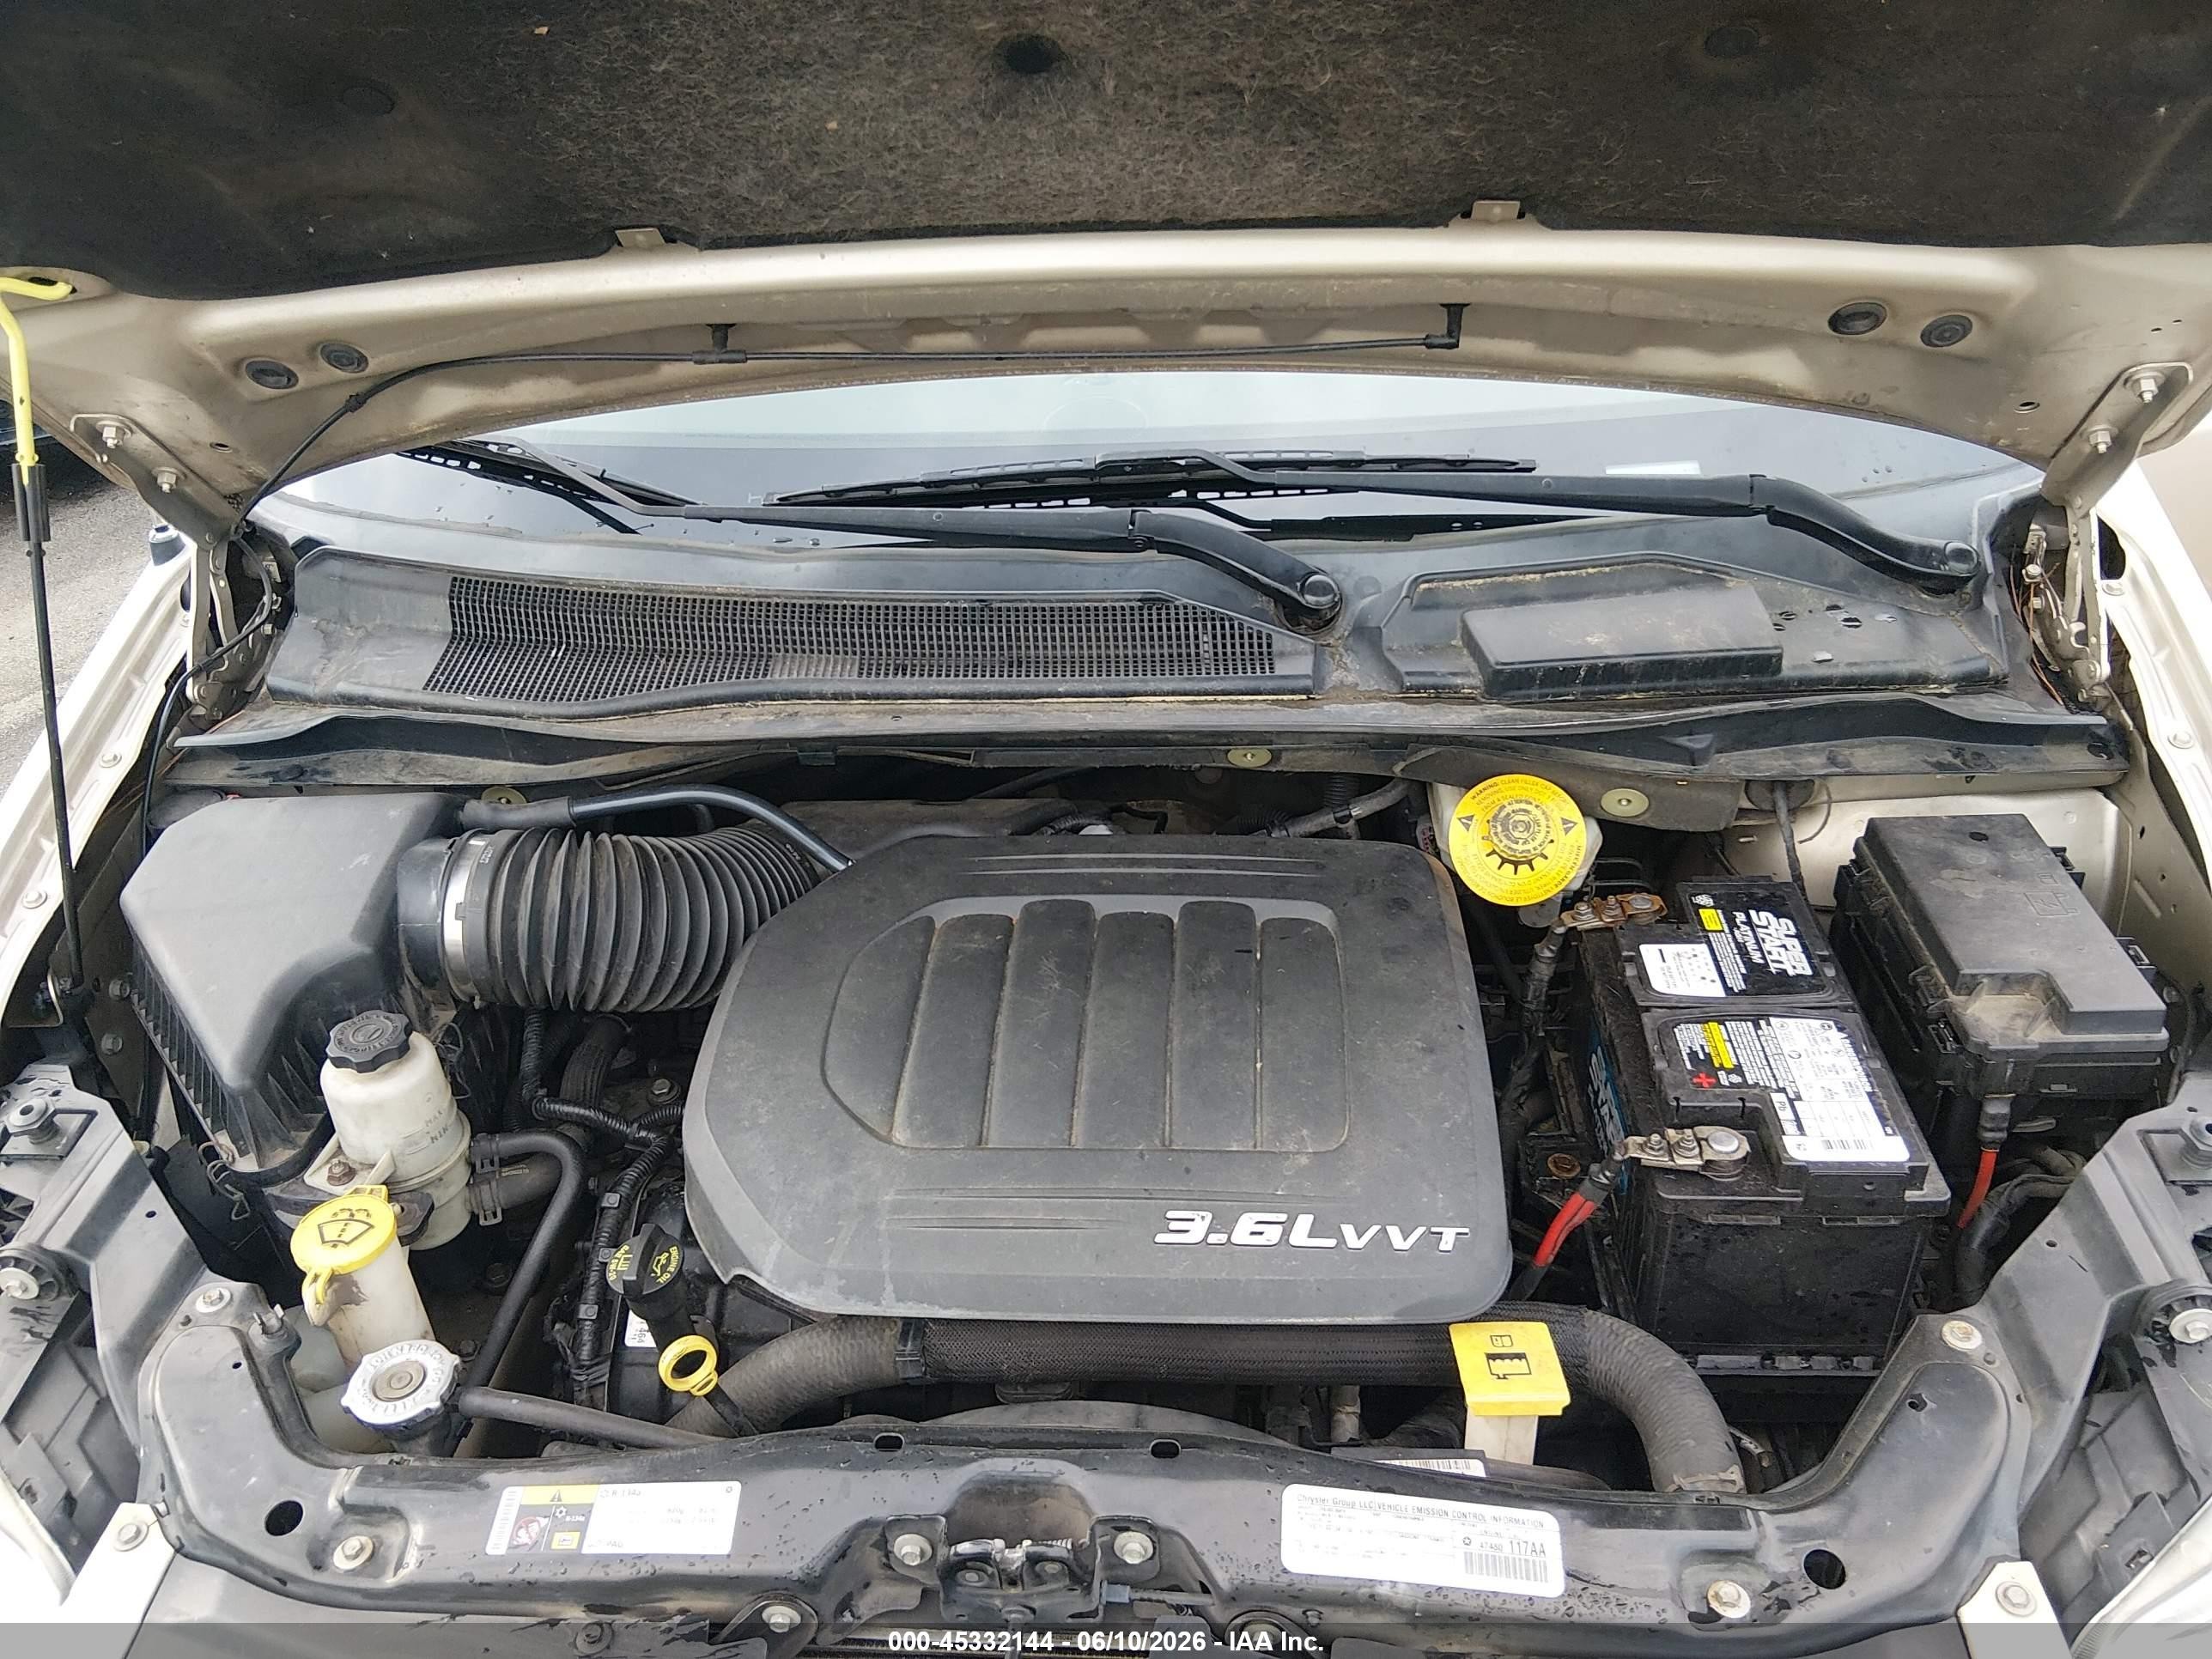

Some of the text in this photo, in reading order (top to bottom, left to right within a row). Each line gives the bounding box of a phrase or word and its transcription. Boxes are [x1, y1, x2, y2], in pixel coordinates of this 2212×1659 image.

[1471, 781, 1499, 800] WARNING:
[1732, 911, 1765, 964] PLATINUM
[1749, 909, 1796, 976] START
[1773, 918, 1813, 975] SUPER
[1776, 1101, 1788, 1112] Pb
[1153, 1210, 1471, 1253] 3.6L VVT
[656, 1246, 679, 1284] ENGINE OIL
[1297, 1493, 1328, 1505] Chrysler
[1332, 1498, 1357, 1509] Group
[1359, 1501, 1375, 1510] LLC
[1377, 1502, 1409, 1513] VEHICLE
[1412, 1505, 1449, 1517] EMISSION
[1451, 1510, 1486, 1522] CONTROL
[1491, 1515, 1544, 1528] INFORMATION
[1509, 1540, 1547, 1558] 117AA
